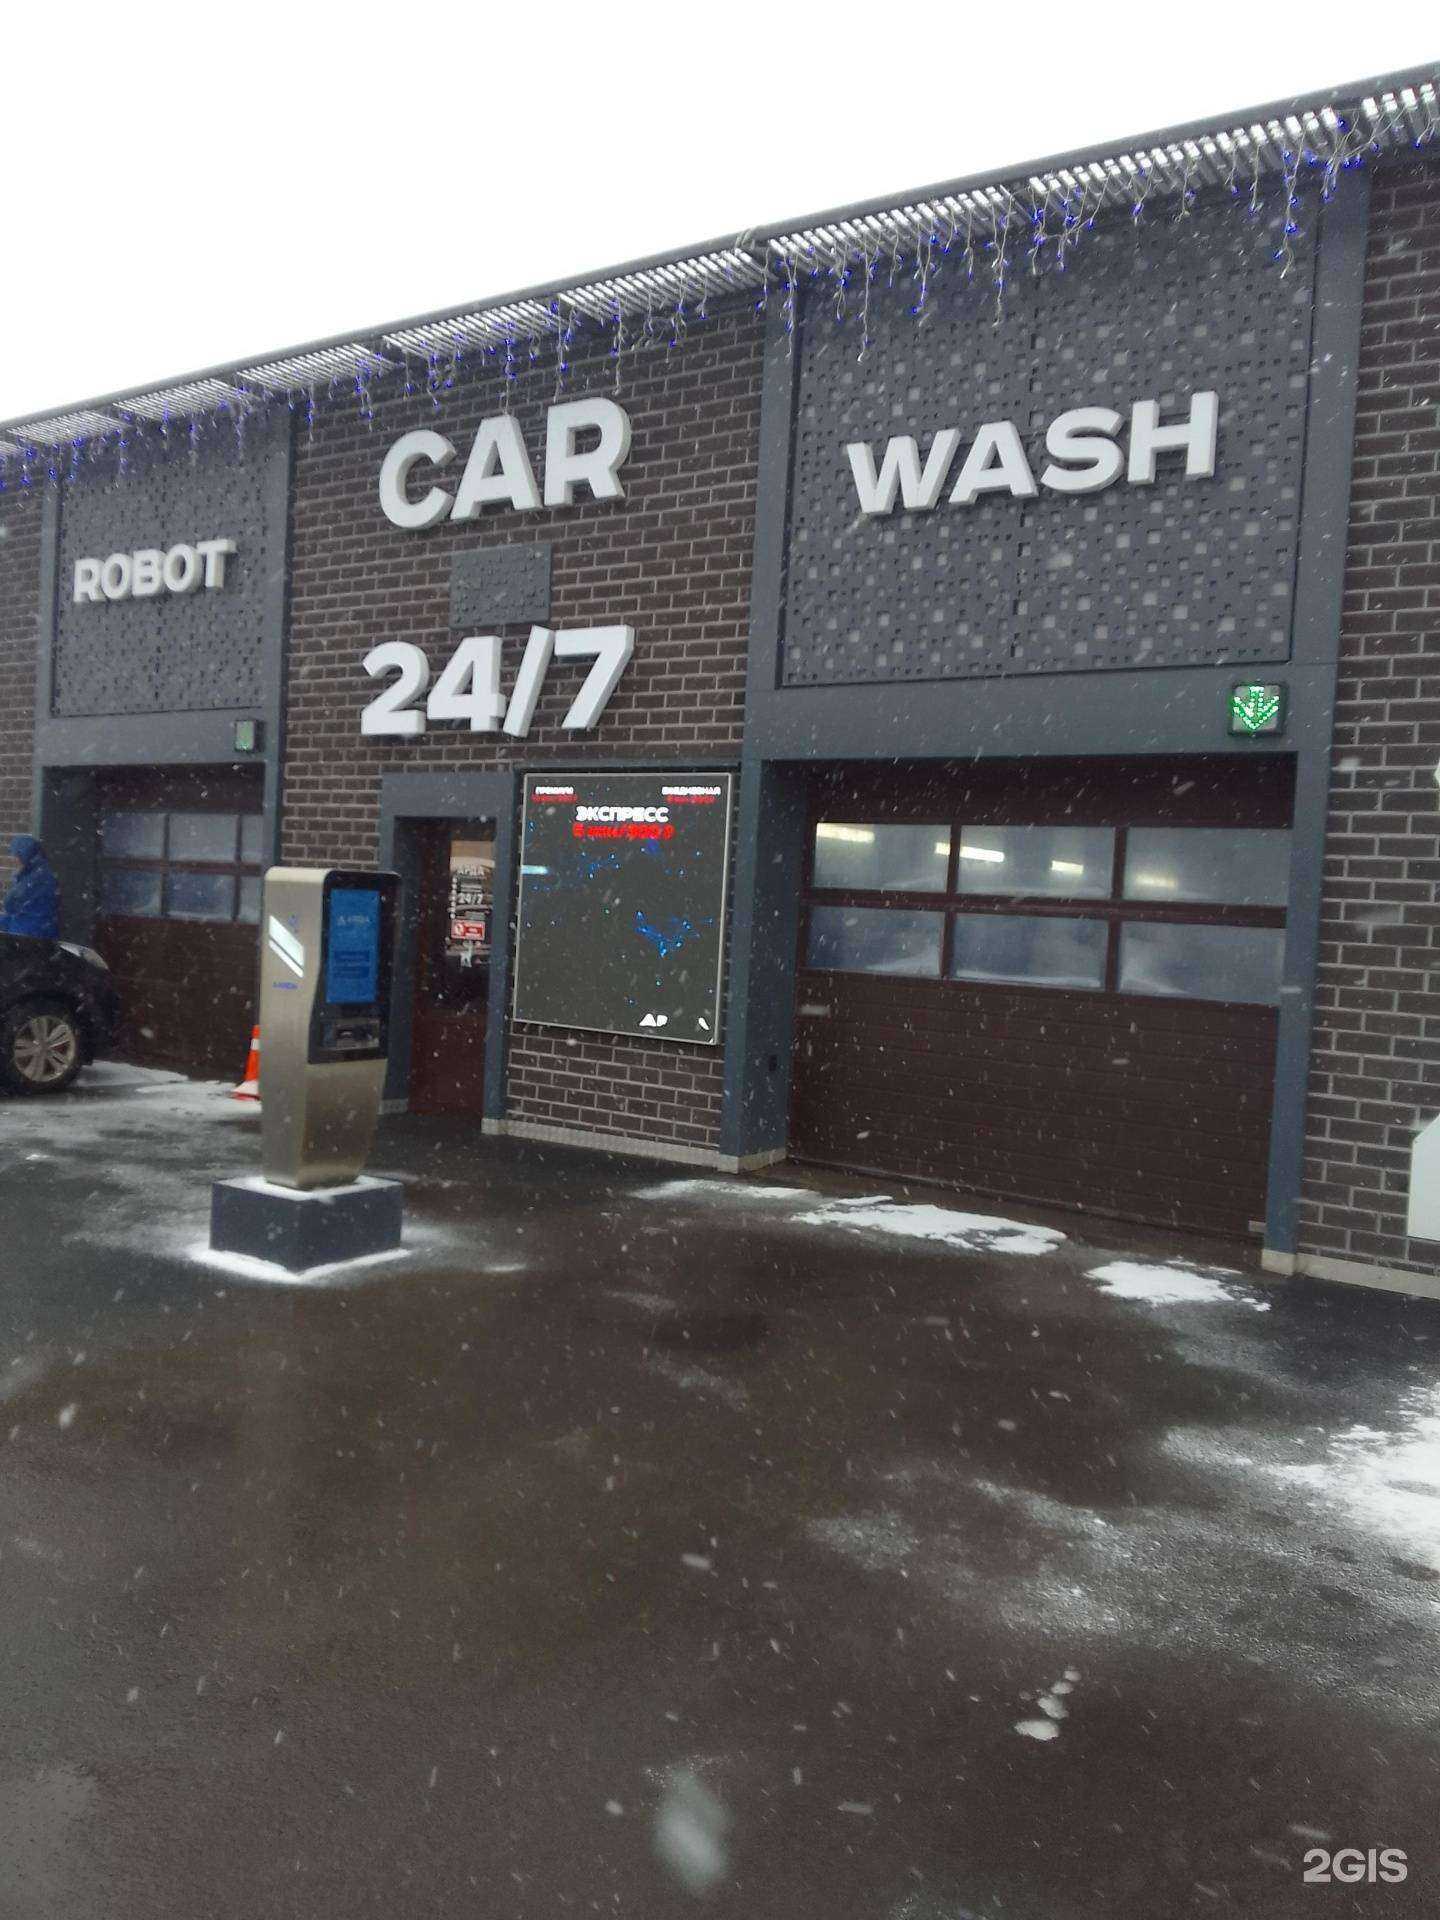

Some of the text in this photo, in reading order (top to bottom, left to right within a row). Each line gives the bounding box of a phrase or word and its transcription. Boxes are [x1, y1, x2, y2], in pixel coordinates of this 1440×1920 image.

[379, 397, 633, 530] CAR
[847, 391, 1219, 515] WASH
[73, 538, 237, 602] ROBOT
[360, 624, 636, 738] 24/7
[575, 805, 670, 823] ЭКСПРЕСС
